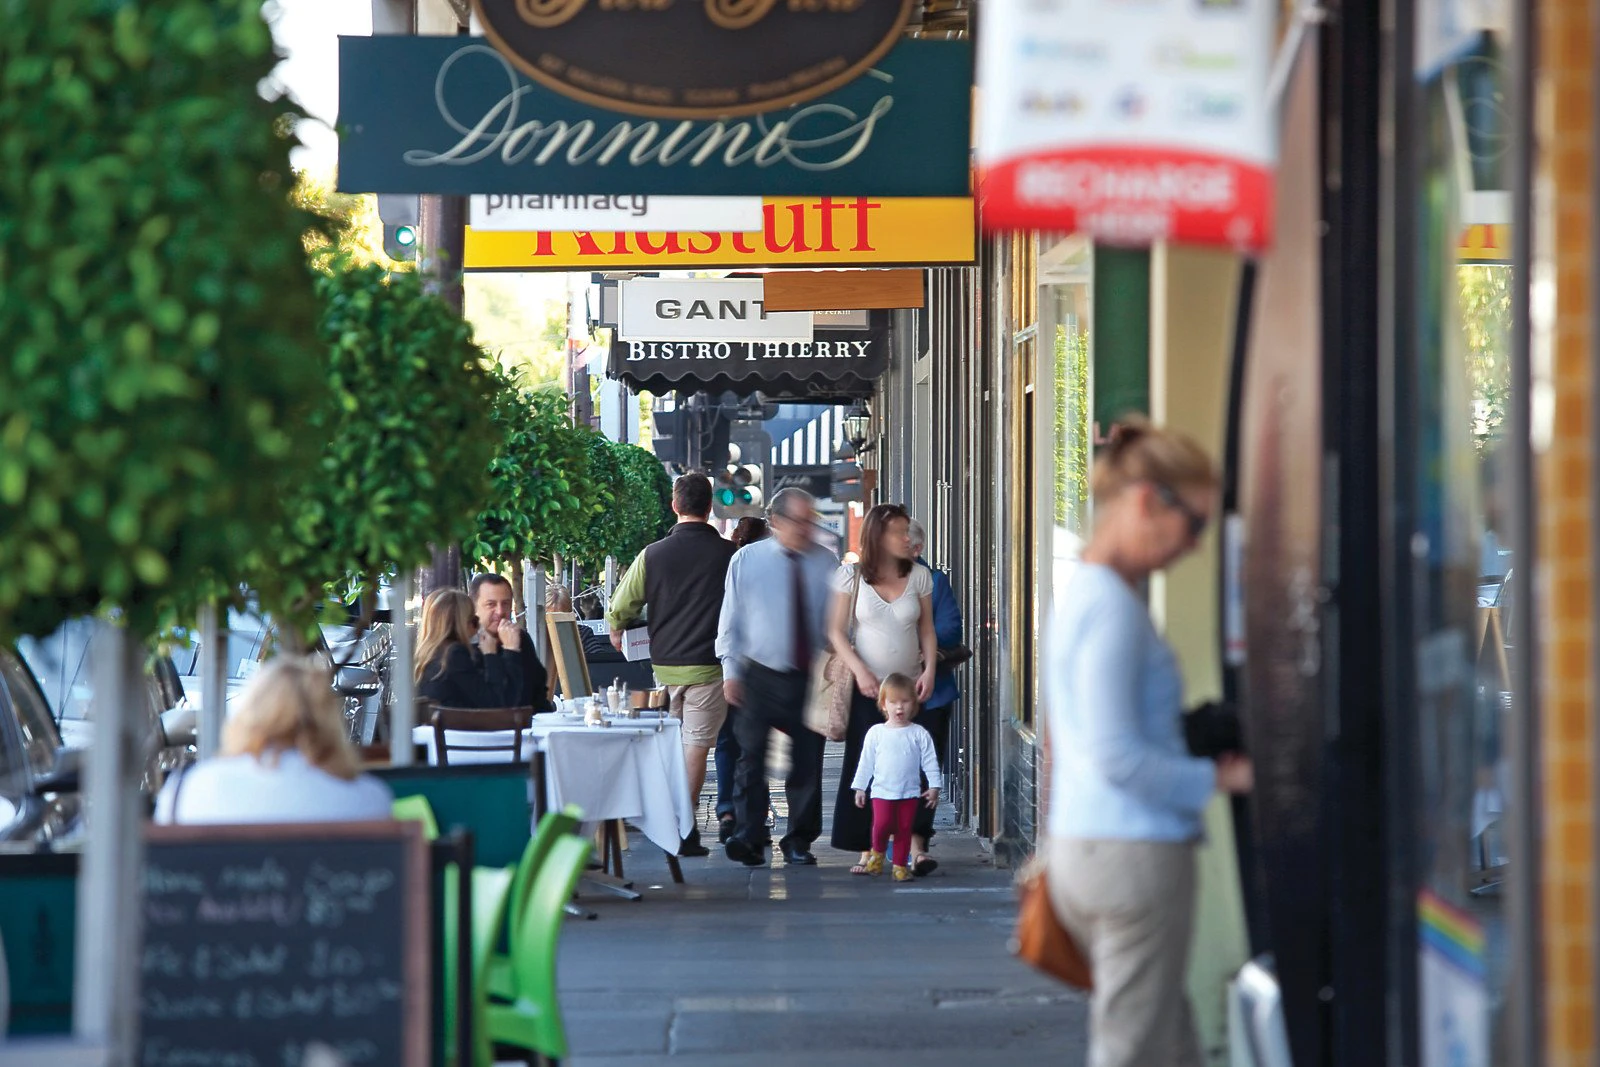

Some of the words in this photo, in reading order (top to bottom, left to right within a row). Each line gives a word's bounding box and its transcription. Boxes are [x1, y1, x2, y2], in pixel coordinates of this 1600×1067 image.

[486, 194, 648, 216] pharmacy
[655, 299, 768, 320] GANT
[626, 341, 731, 361] BISTRO
[740, 340, 872, 361] THIERRY
